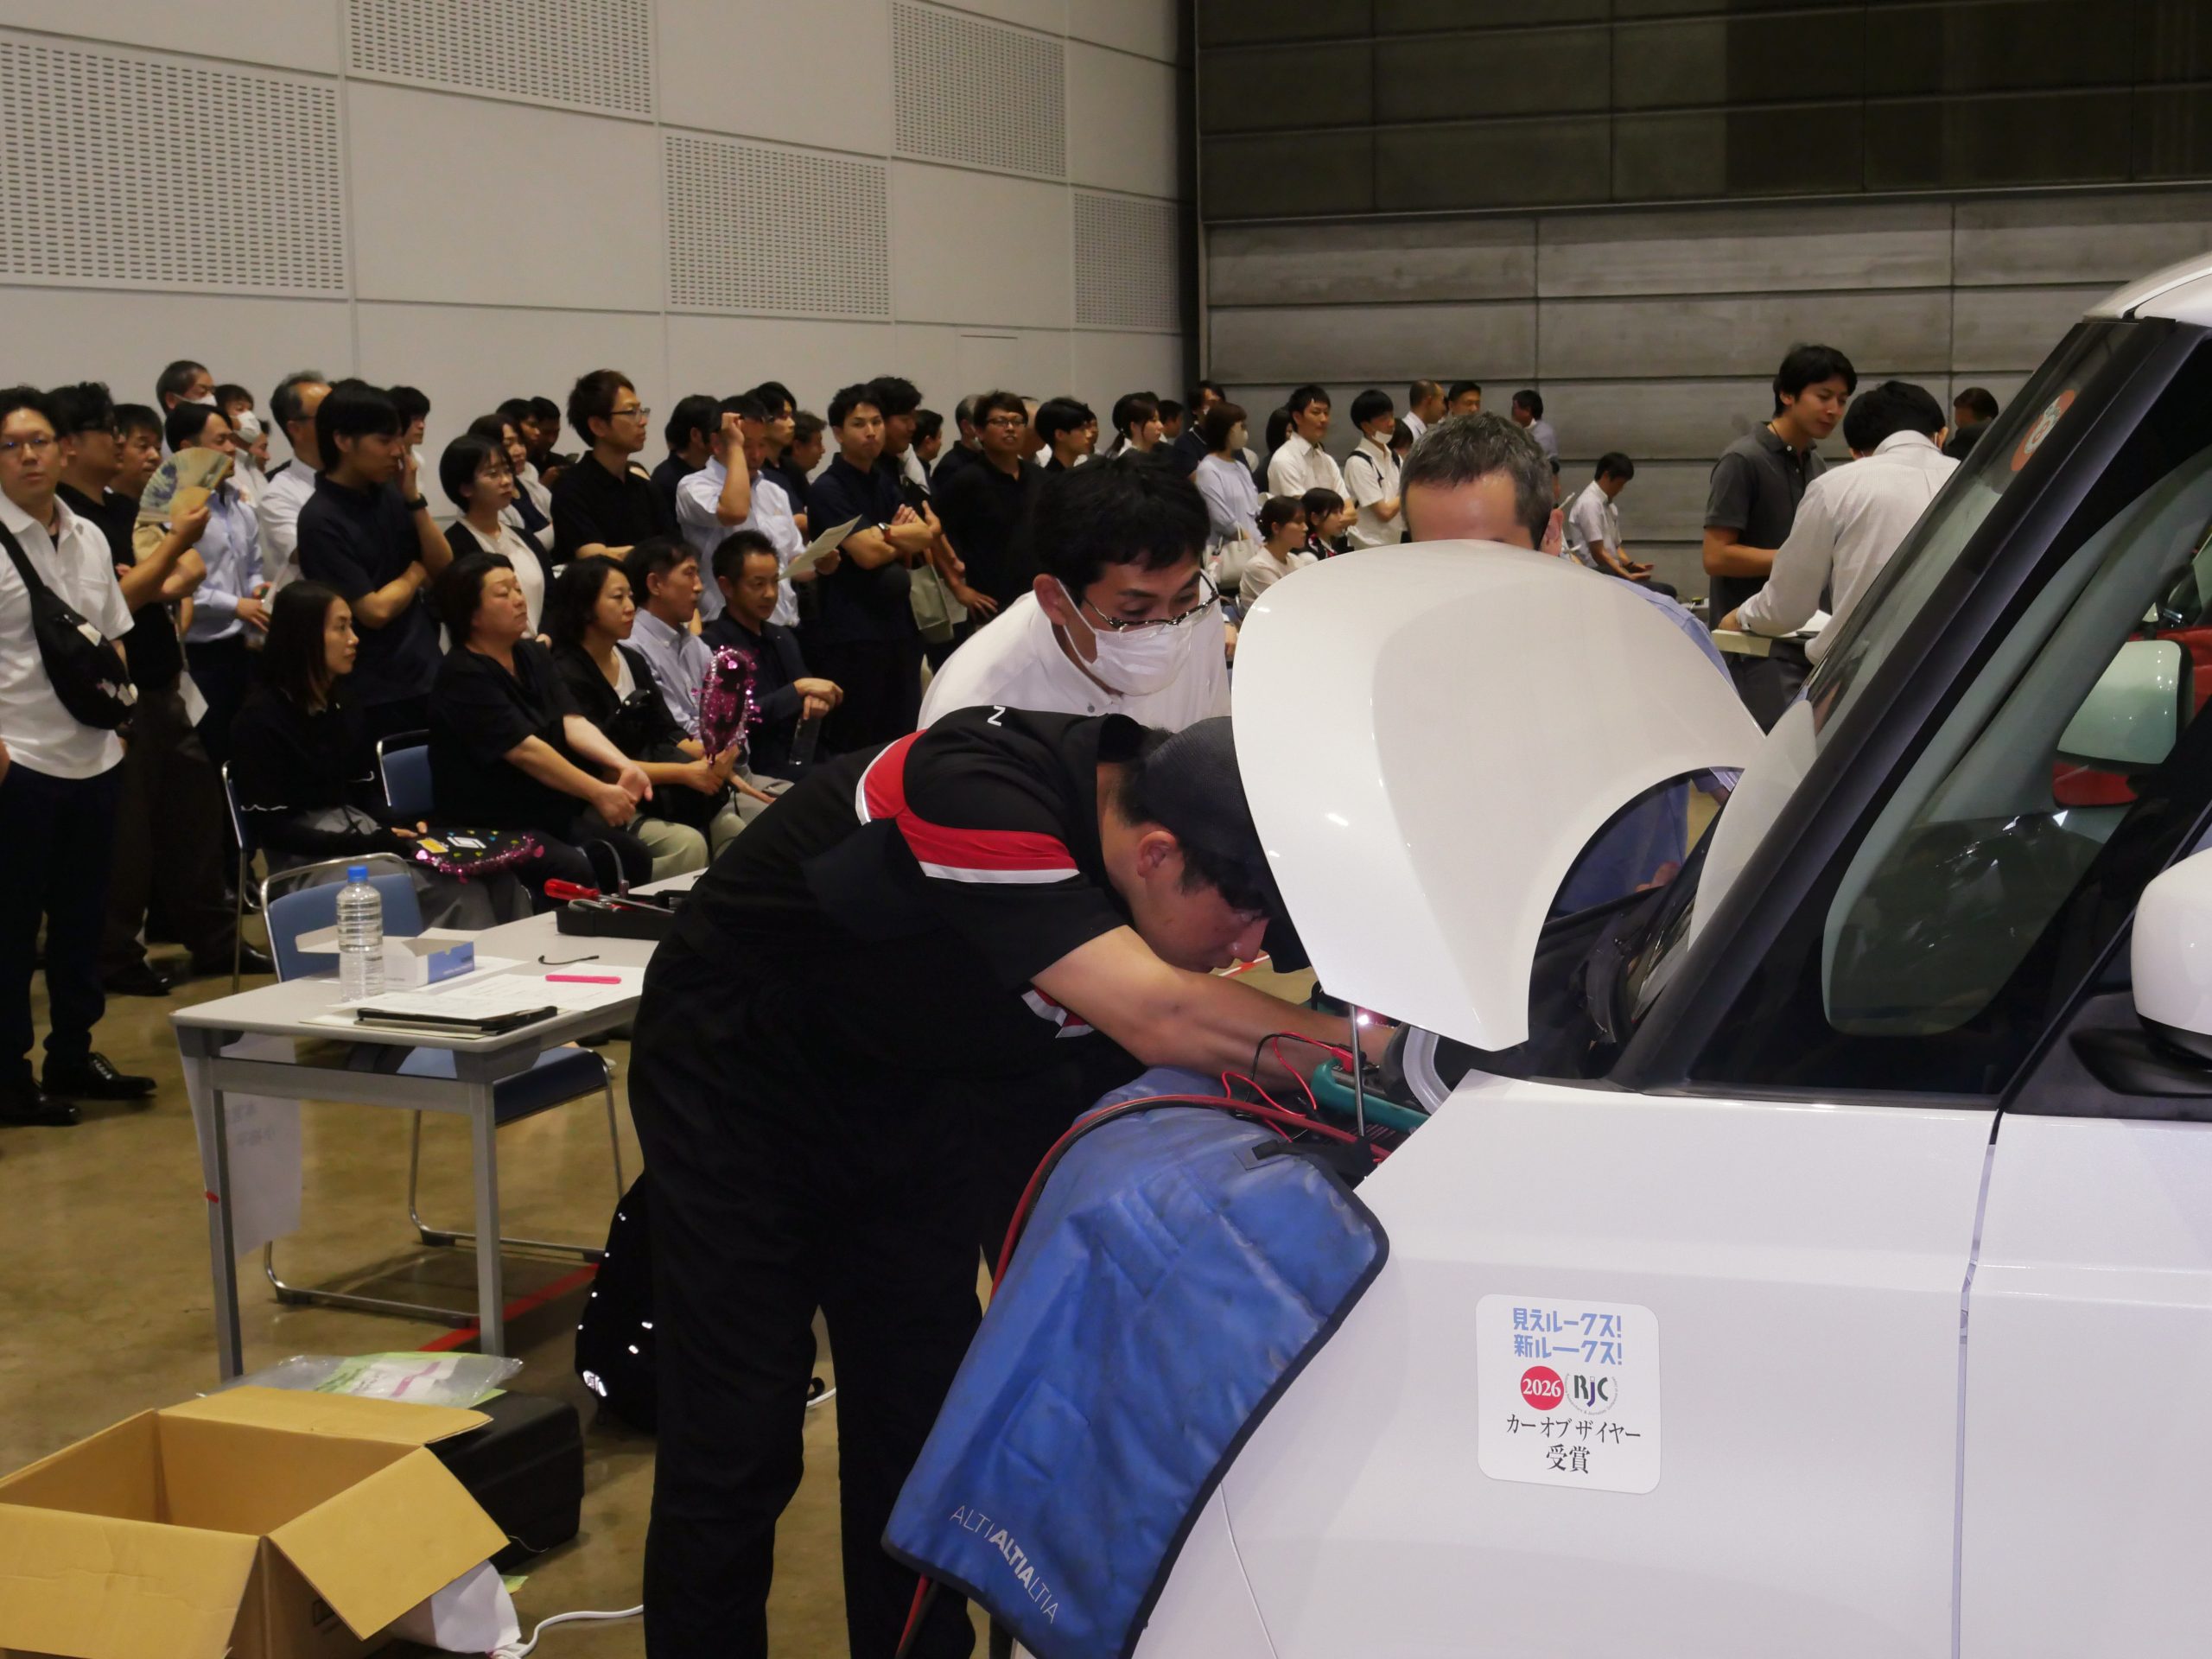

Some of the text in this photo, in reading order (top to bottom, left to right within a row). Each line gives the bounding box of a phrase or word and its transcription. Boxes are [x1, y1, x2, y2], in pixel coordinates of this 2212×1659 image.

[1522, 1378, 1561, 1397] 2026
[1506, 1414, 1641, 1444] カーオブザイヤー
[1546, 1444, 1591, 1474] 受賞
